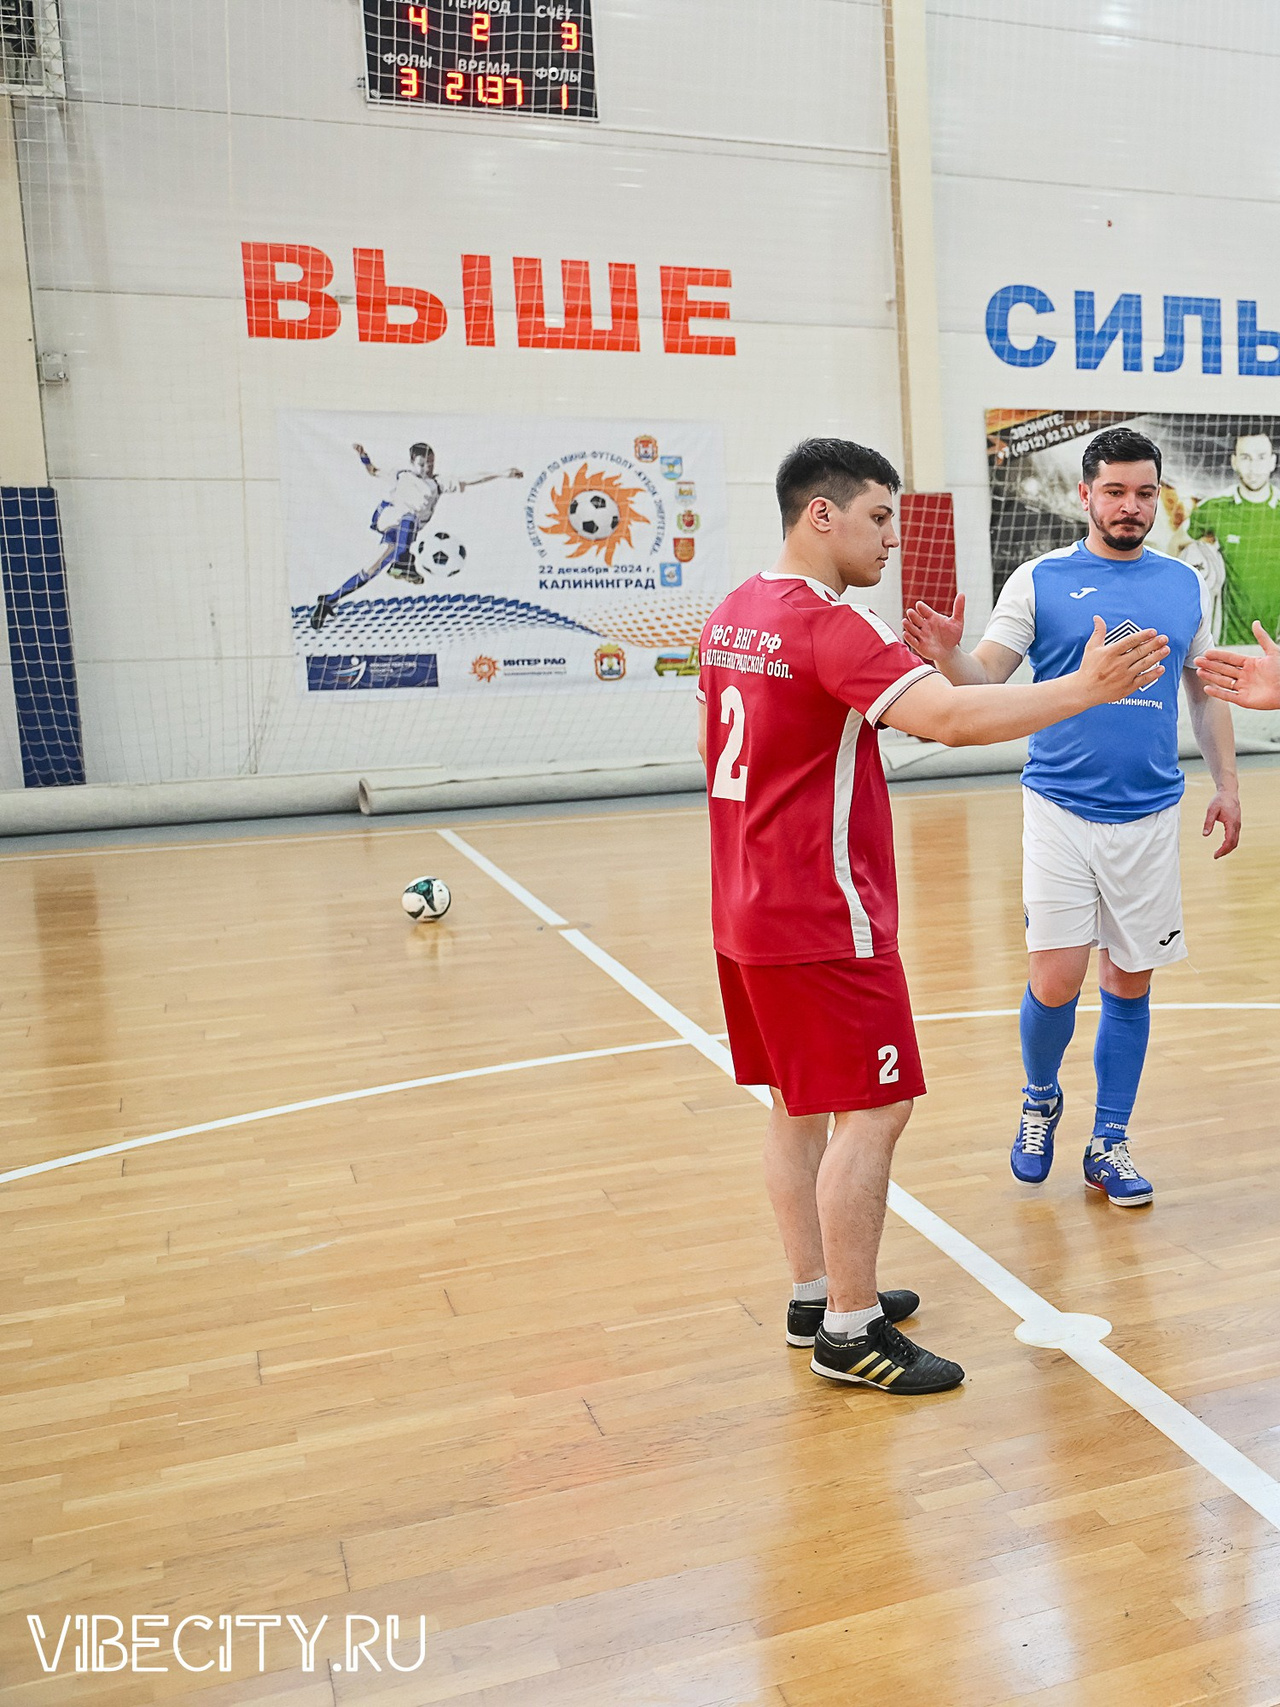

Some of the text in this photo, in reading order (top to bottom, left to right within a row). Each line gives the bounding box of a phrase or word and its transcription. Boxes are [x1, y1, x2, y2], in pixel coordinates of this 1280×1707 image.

[408, 6, 578, 50] 4 2 3
[383, 52, 581, 83] ФОЛЫ ВРЕМЯ ФОЛЫ
[400, 68, 418, 97] 3
[561, 84, 568, 110] 1
[241, 241, 737, 356] ВЫШЕ
[538, 578, 656, 590] КАЛИНИНГРАД
[539, 565, 554, 575] 22
[557, 565, 609, 576] декабря
[613, 564, 643, 573] 2024
[708, 624, 783, 654] УФС ВНГ РФ
[503, 657, 566, 667] ИНТЕР РАО
[767, 658, 794, 680] обл.
[711, 685, 749, 803] 2
[877, 1044, 899, 1085] 2
